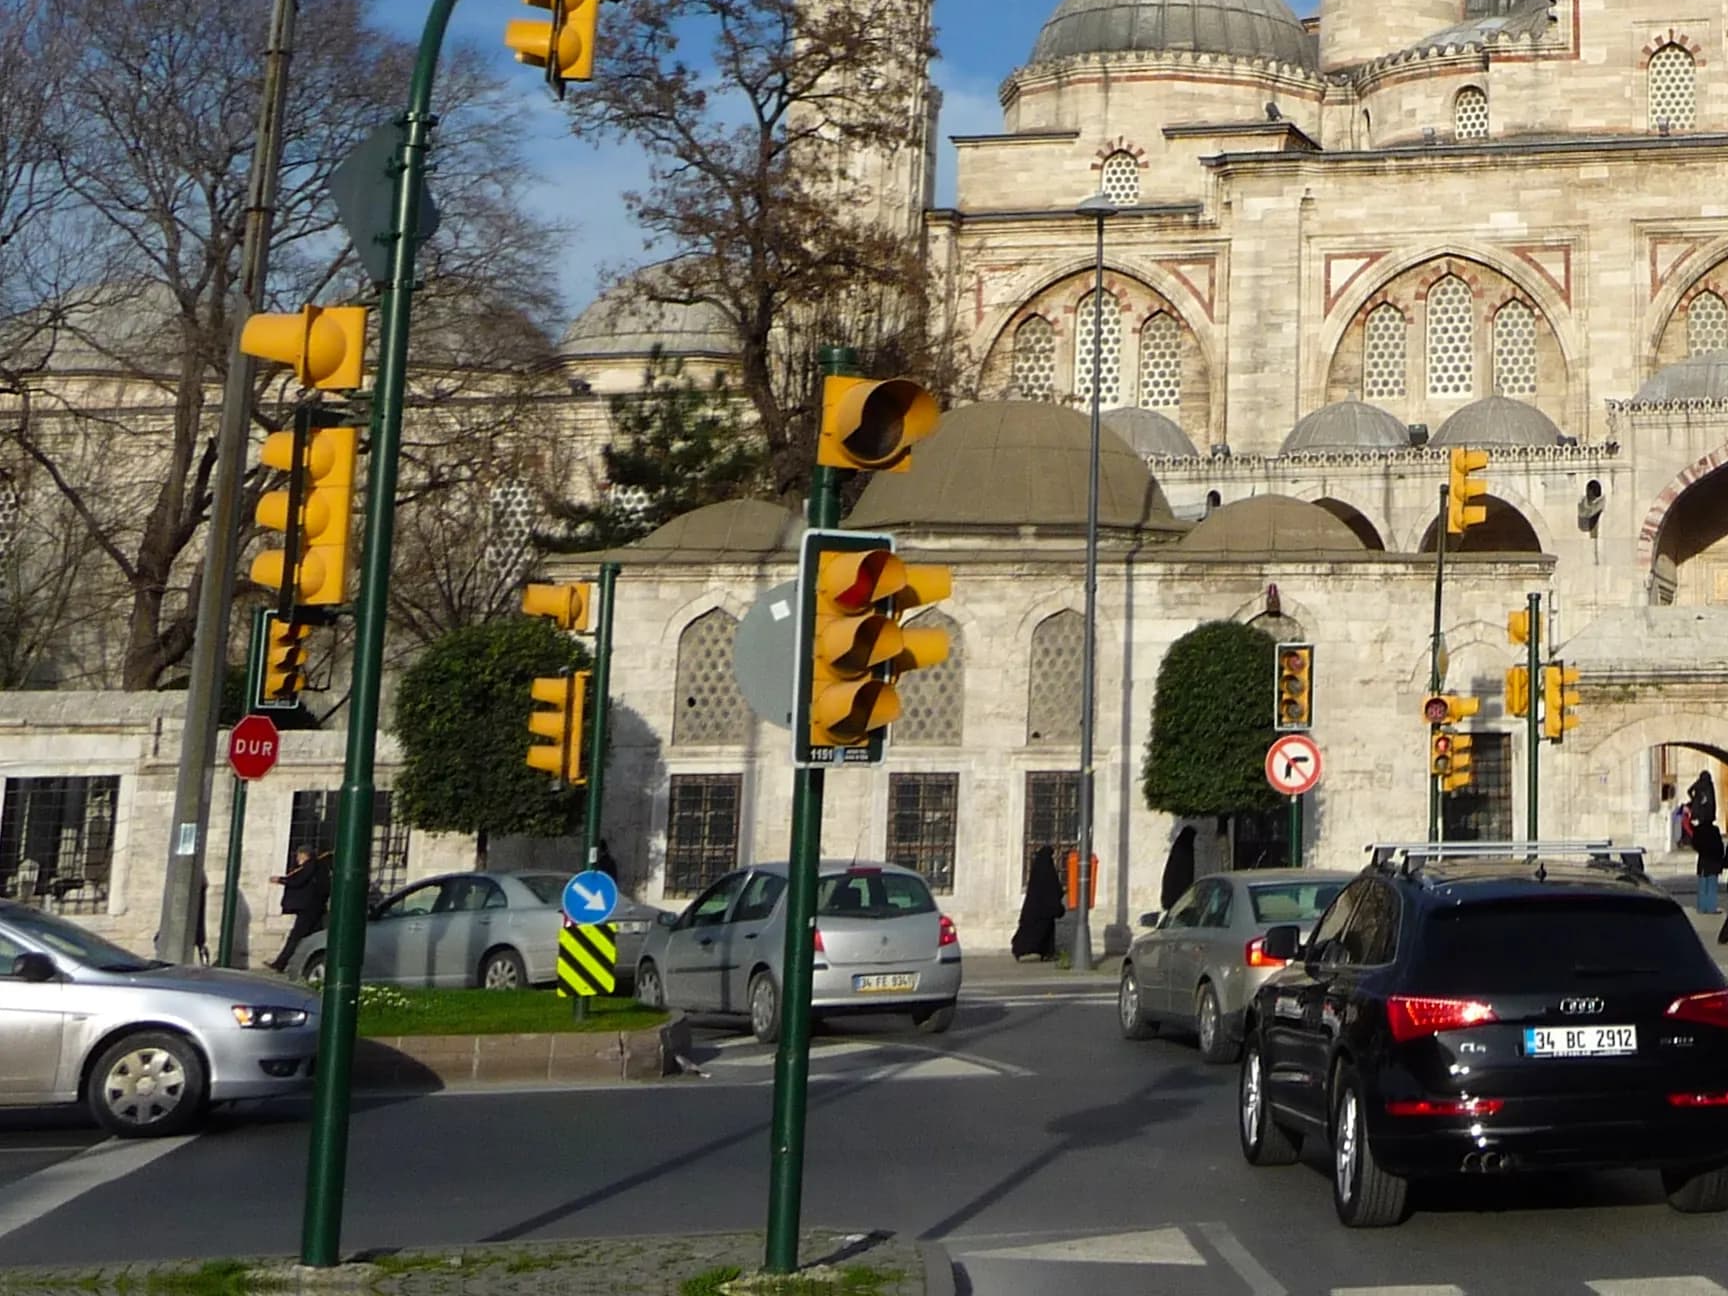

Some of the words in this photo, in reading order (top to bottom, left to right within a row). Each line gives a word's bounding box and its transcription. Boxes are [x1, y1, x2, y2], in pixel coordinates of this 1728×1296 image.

[235, 738, 273, 756] DUR
[810, 748, 833, 760] 1151
[1536, 1031, 1555, 1050] 34
[1567, 1030, 1585, 1048] BC
[1596, 1029, 1633, 1047] 2912
